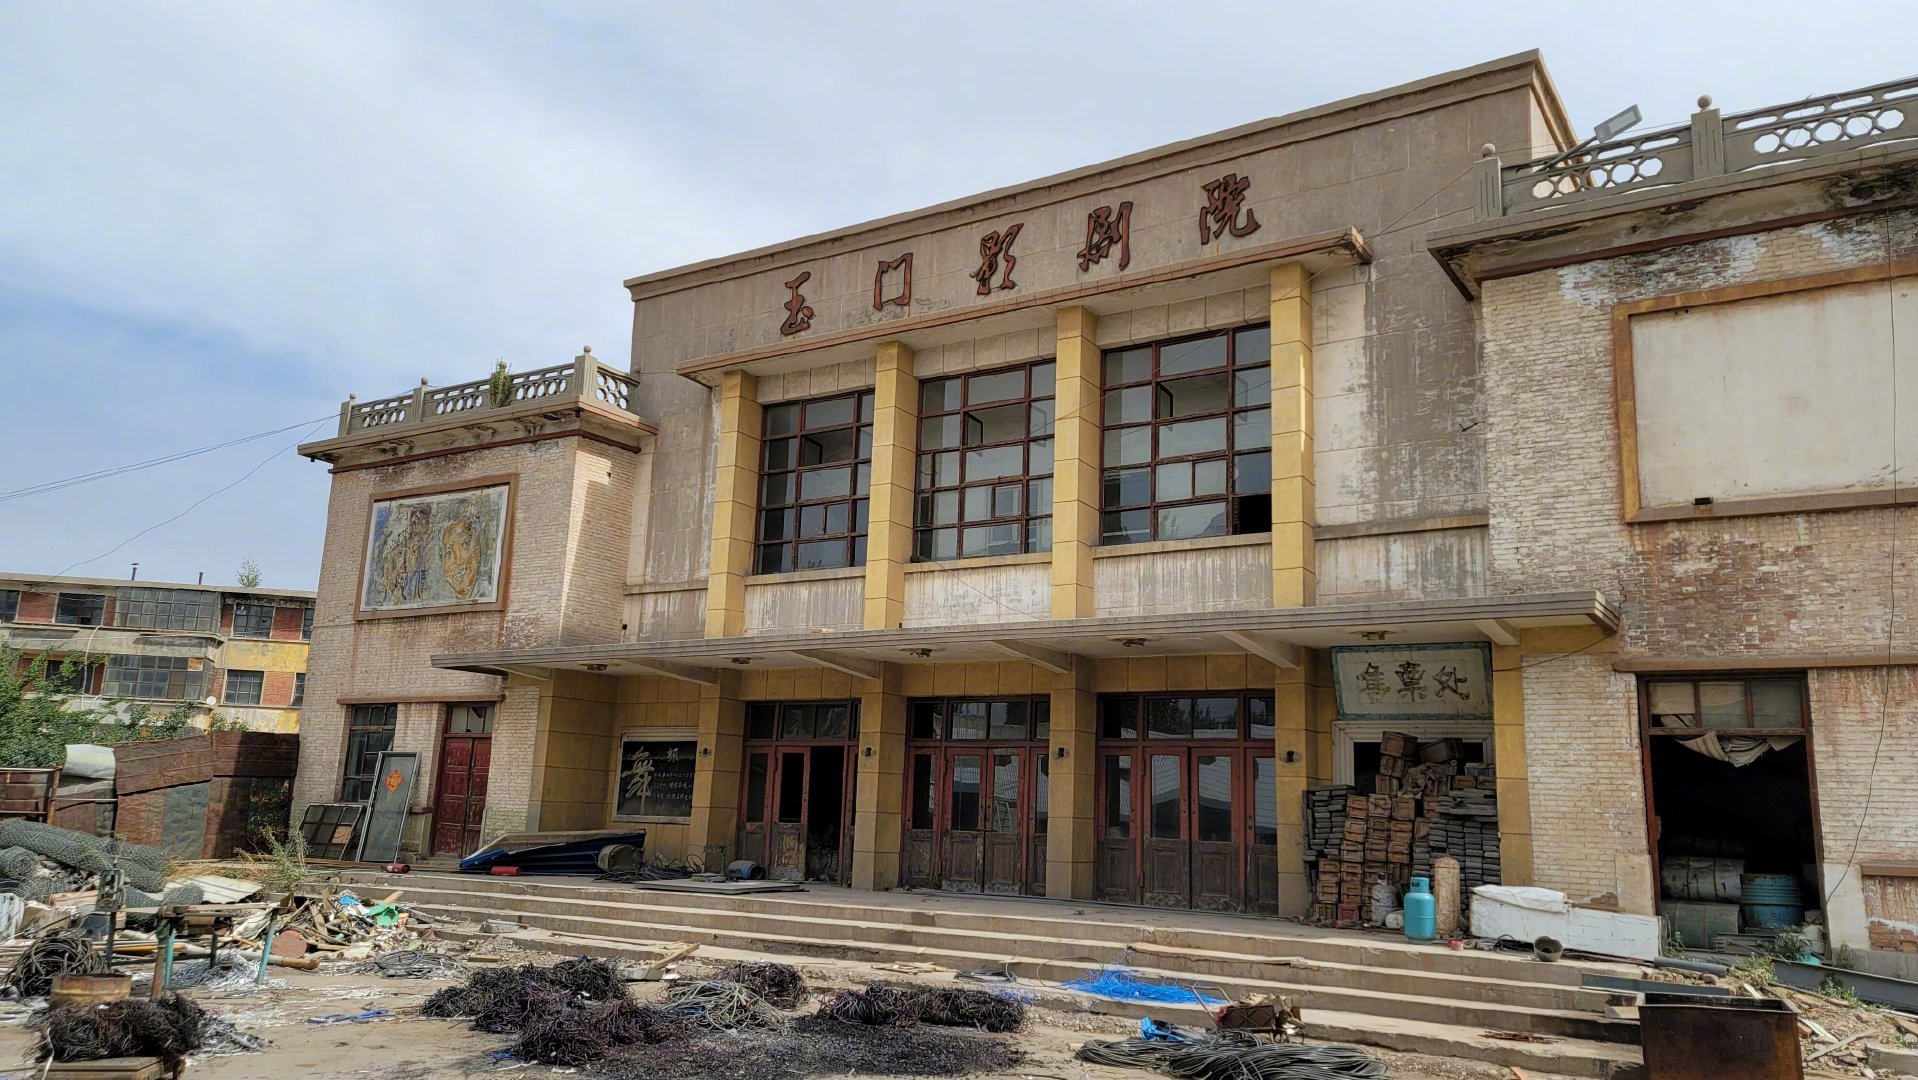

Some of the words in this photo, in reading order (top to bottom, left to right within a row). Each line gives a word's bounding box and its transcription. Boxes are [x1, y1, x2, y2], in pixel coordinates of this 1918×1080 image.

[779, 172, 1262, 336] 玉门影剧院
[1356, 660, 1471, 704] 售票处
